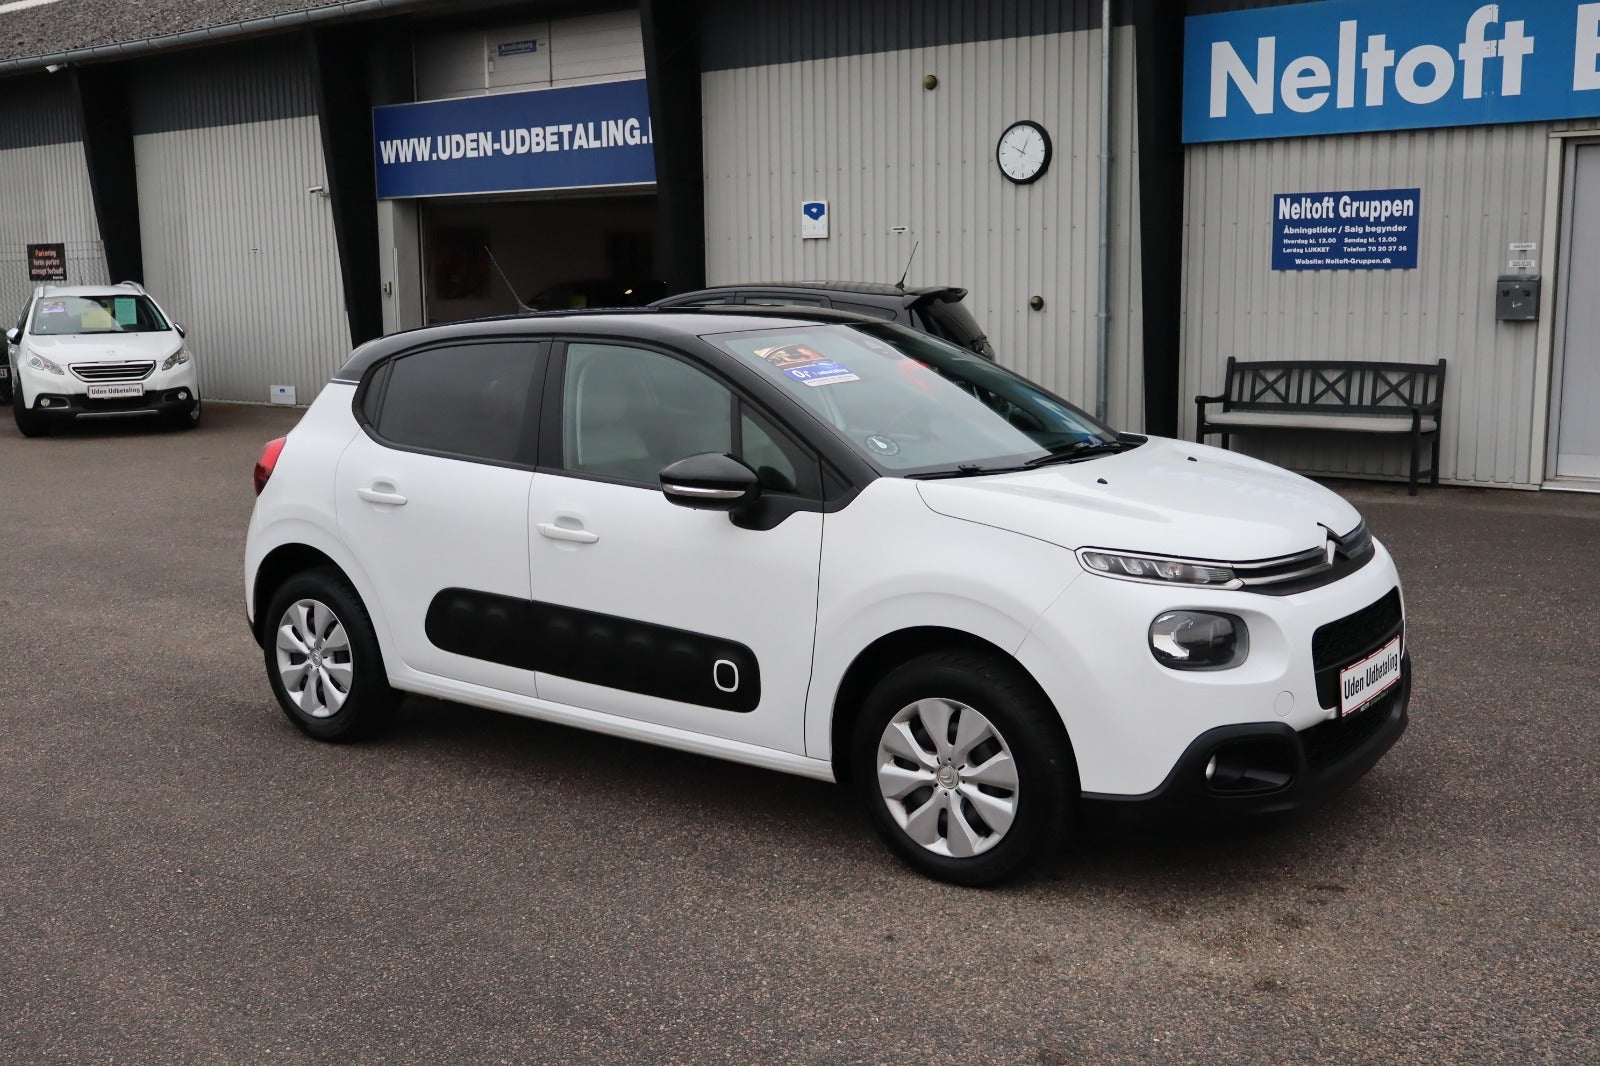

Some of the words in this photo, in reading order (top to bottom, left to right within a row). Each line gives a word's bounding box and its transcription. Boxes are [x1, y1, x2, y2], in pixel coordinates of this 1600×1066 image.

[1209, 3, 1535, 118] Neltoft
[379, 116, 653, 164] WWW.UDEN-UDBETALING.
[1279, 196, 1335, 220] Neltoft
[1338, 195, 1414, 222] Gruppen
[1283, 225, 1337, 235] Åbningstider
[1344, 225, 1364, 234] Salg
[1365, 224, 1408, 234] begynder
[1344, 677, 1364, 700] Uden
[1366, 653, 1398, 687] Udbetaling
